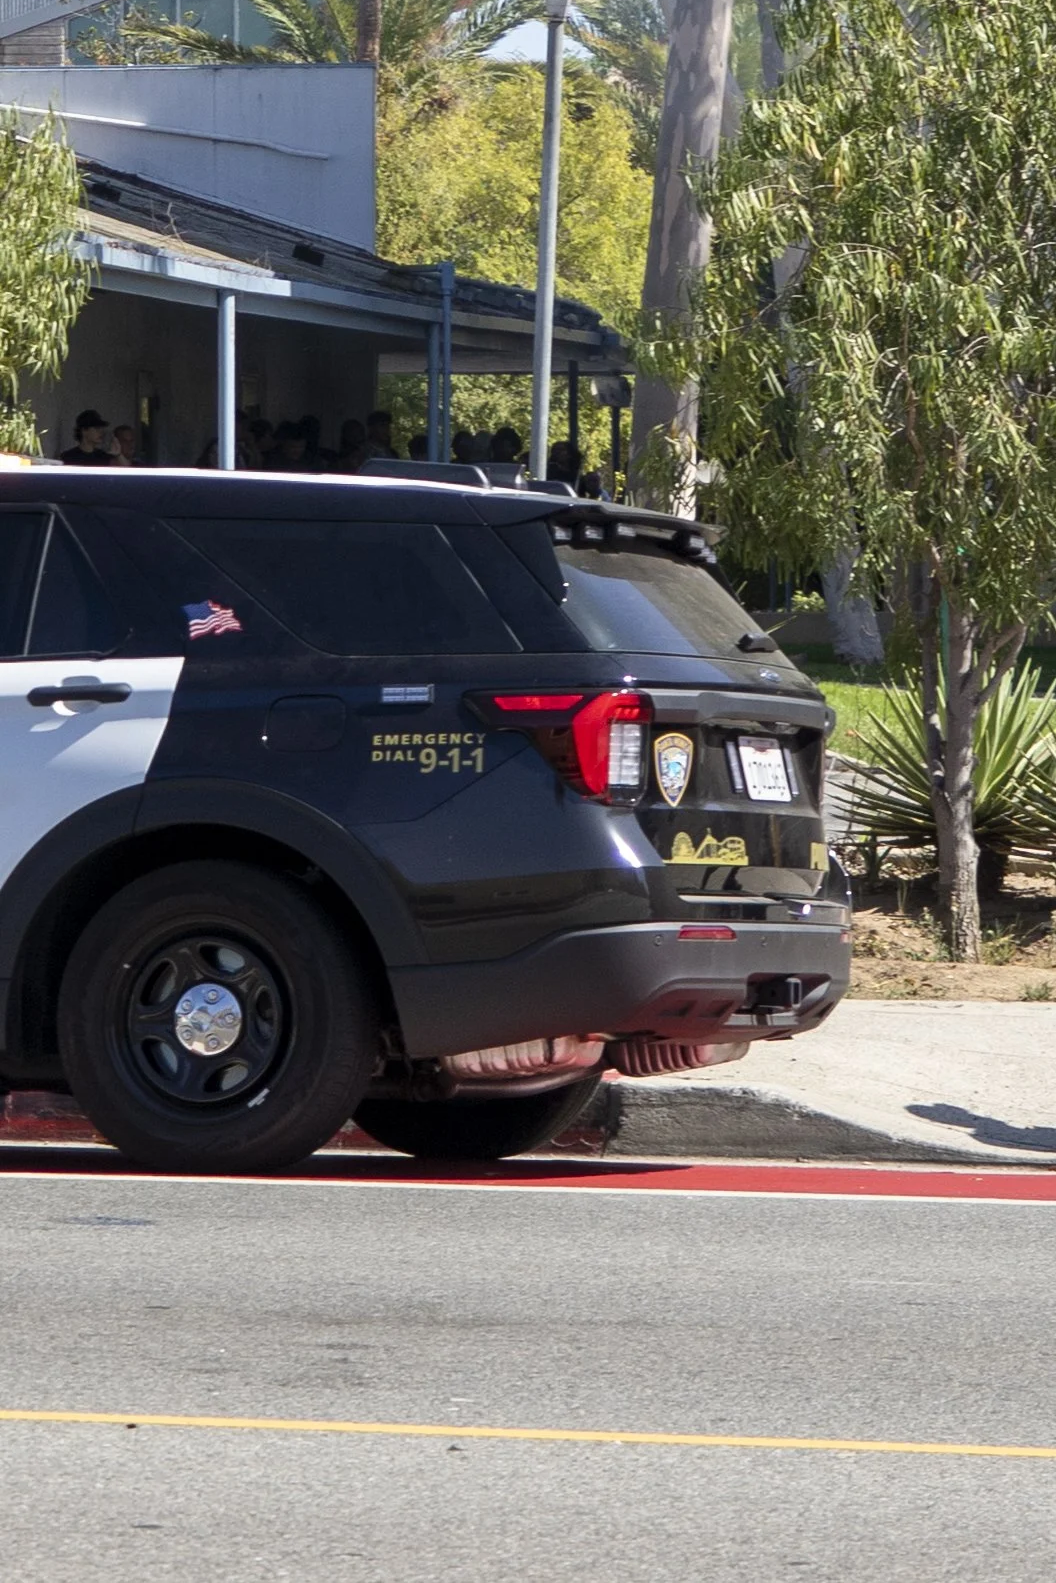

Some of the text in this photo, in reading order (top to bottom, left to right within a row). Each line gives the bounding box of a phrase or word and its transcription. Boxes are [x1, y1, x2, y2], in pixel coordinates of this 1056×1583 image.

[372, 733, 486, 746] EMERGENCY
[371, 747, 484, 773] DIAL 9-1-1
